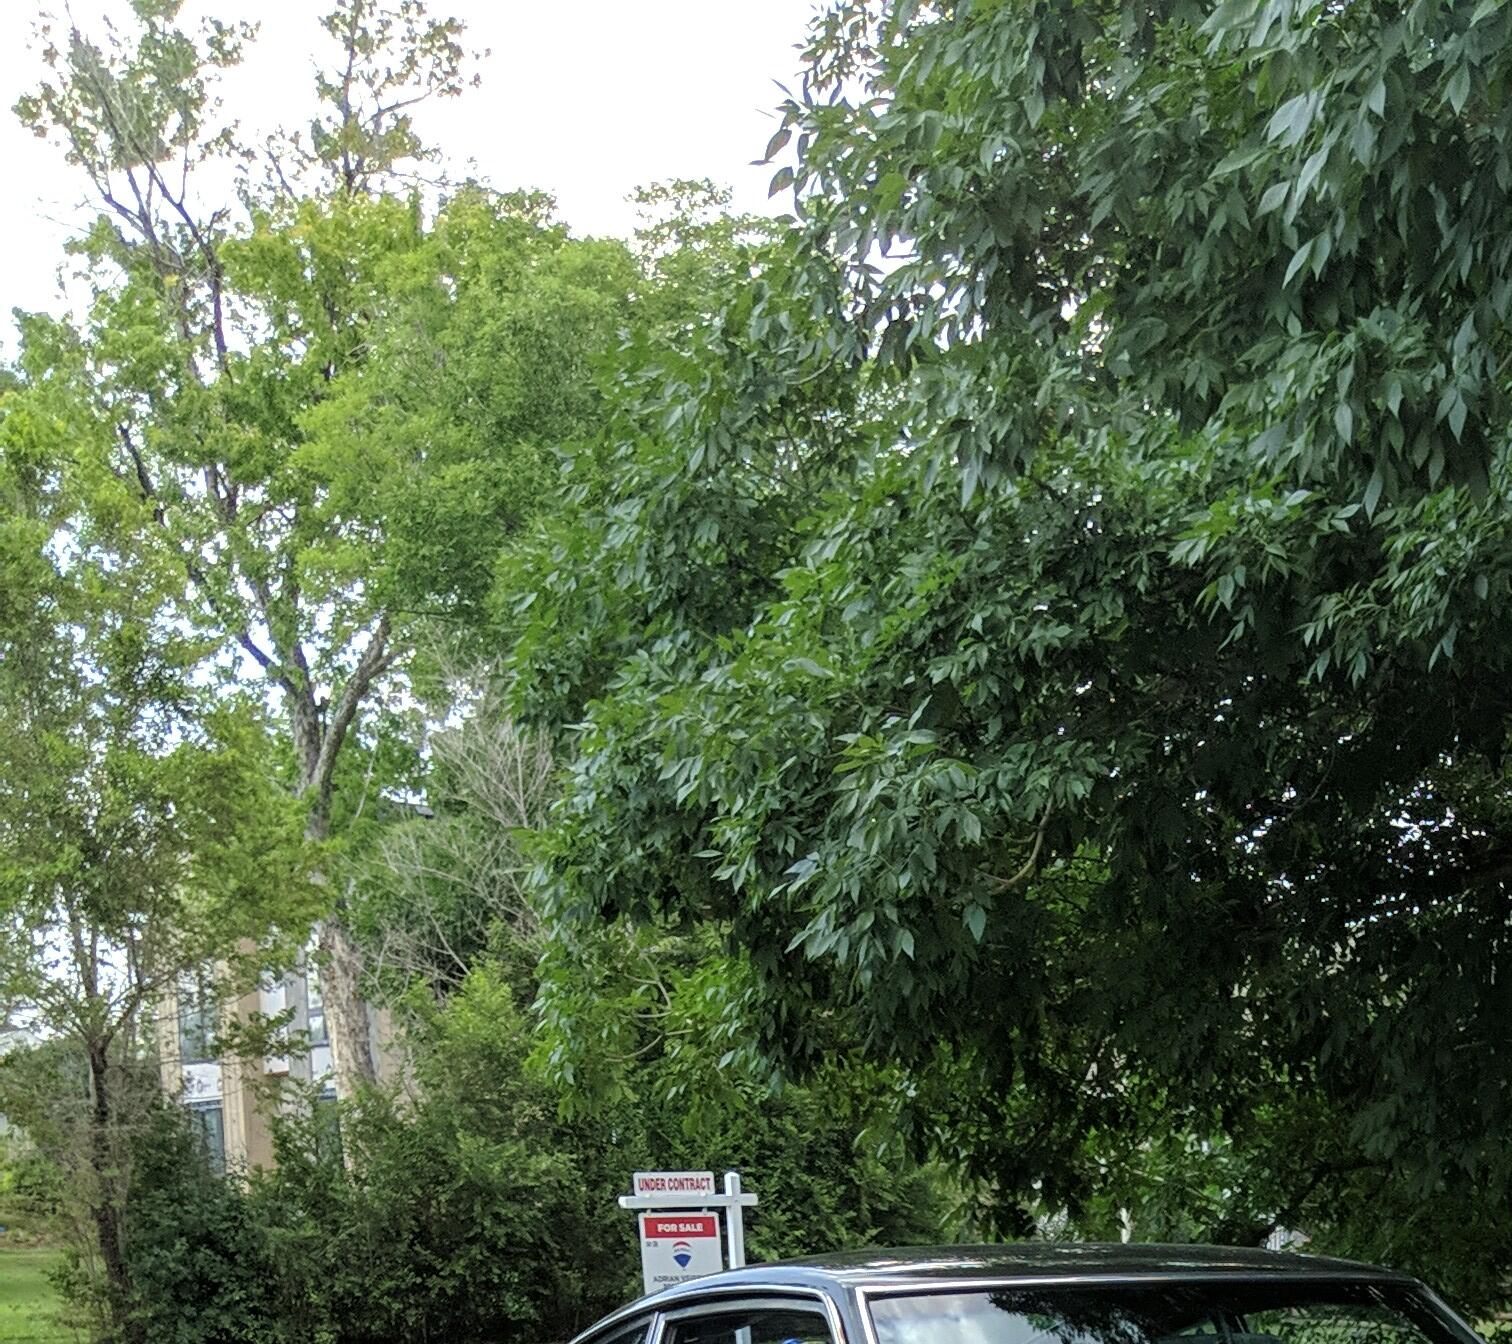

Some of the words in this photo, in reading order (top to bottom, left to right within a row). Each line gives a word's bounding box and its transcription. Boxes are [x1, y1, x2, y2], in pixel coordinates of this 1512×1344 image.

[639, 1178, 666, 1191] UNDER
[668, 1177, 710, 1190] CONTRACT
[657, 1224, 677, 1232] FOR
[679, 1223, 703, 1232] SALE
